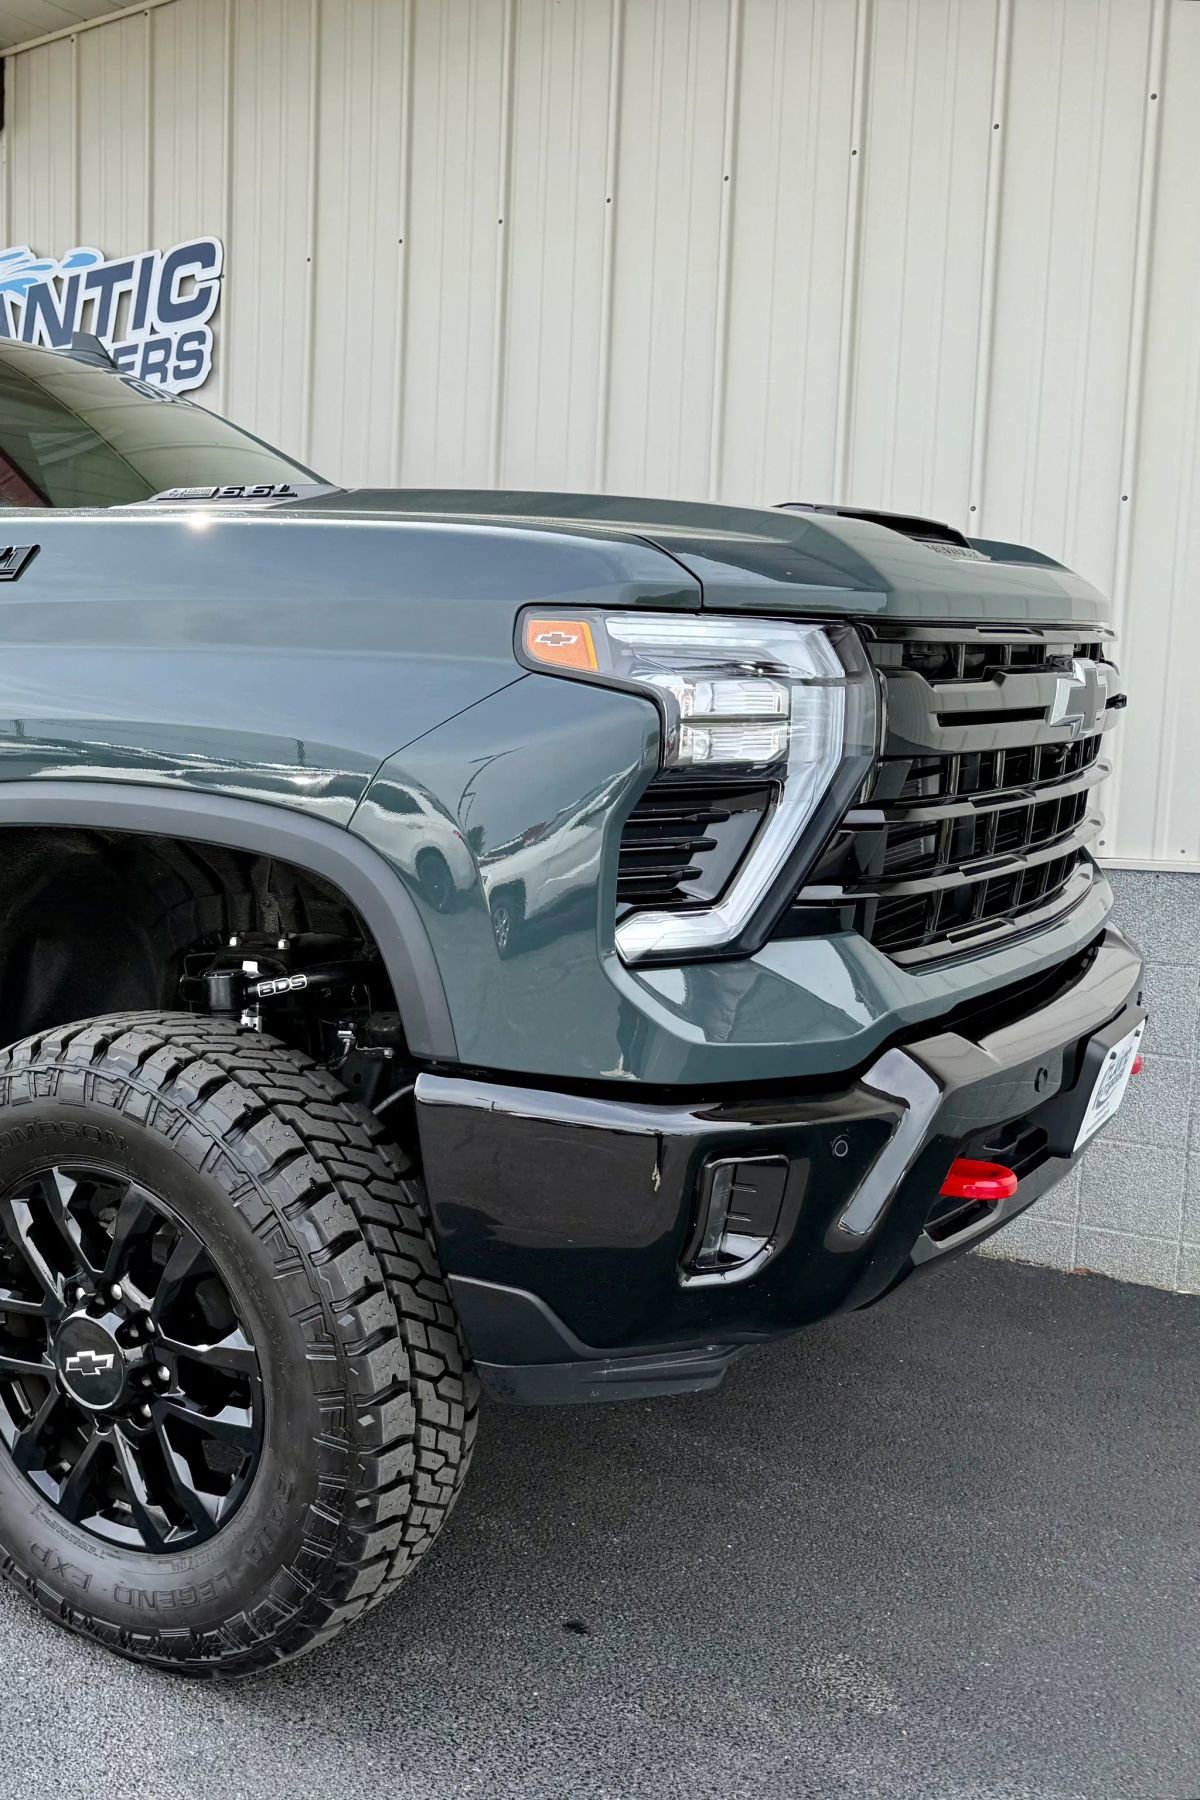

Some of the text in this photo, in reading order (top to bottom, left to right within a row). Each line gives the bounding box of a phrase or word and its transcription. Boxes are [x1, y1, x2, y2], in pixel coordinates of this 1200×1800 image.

[113, 331, 207, 384] ERS
[216, 484, 298, 499] 6.6L
[257, 974, 308, 998] BDS
[31, 1542, 95, 1592] EXP
[113, 1568, 236, 1610] LEGEND
